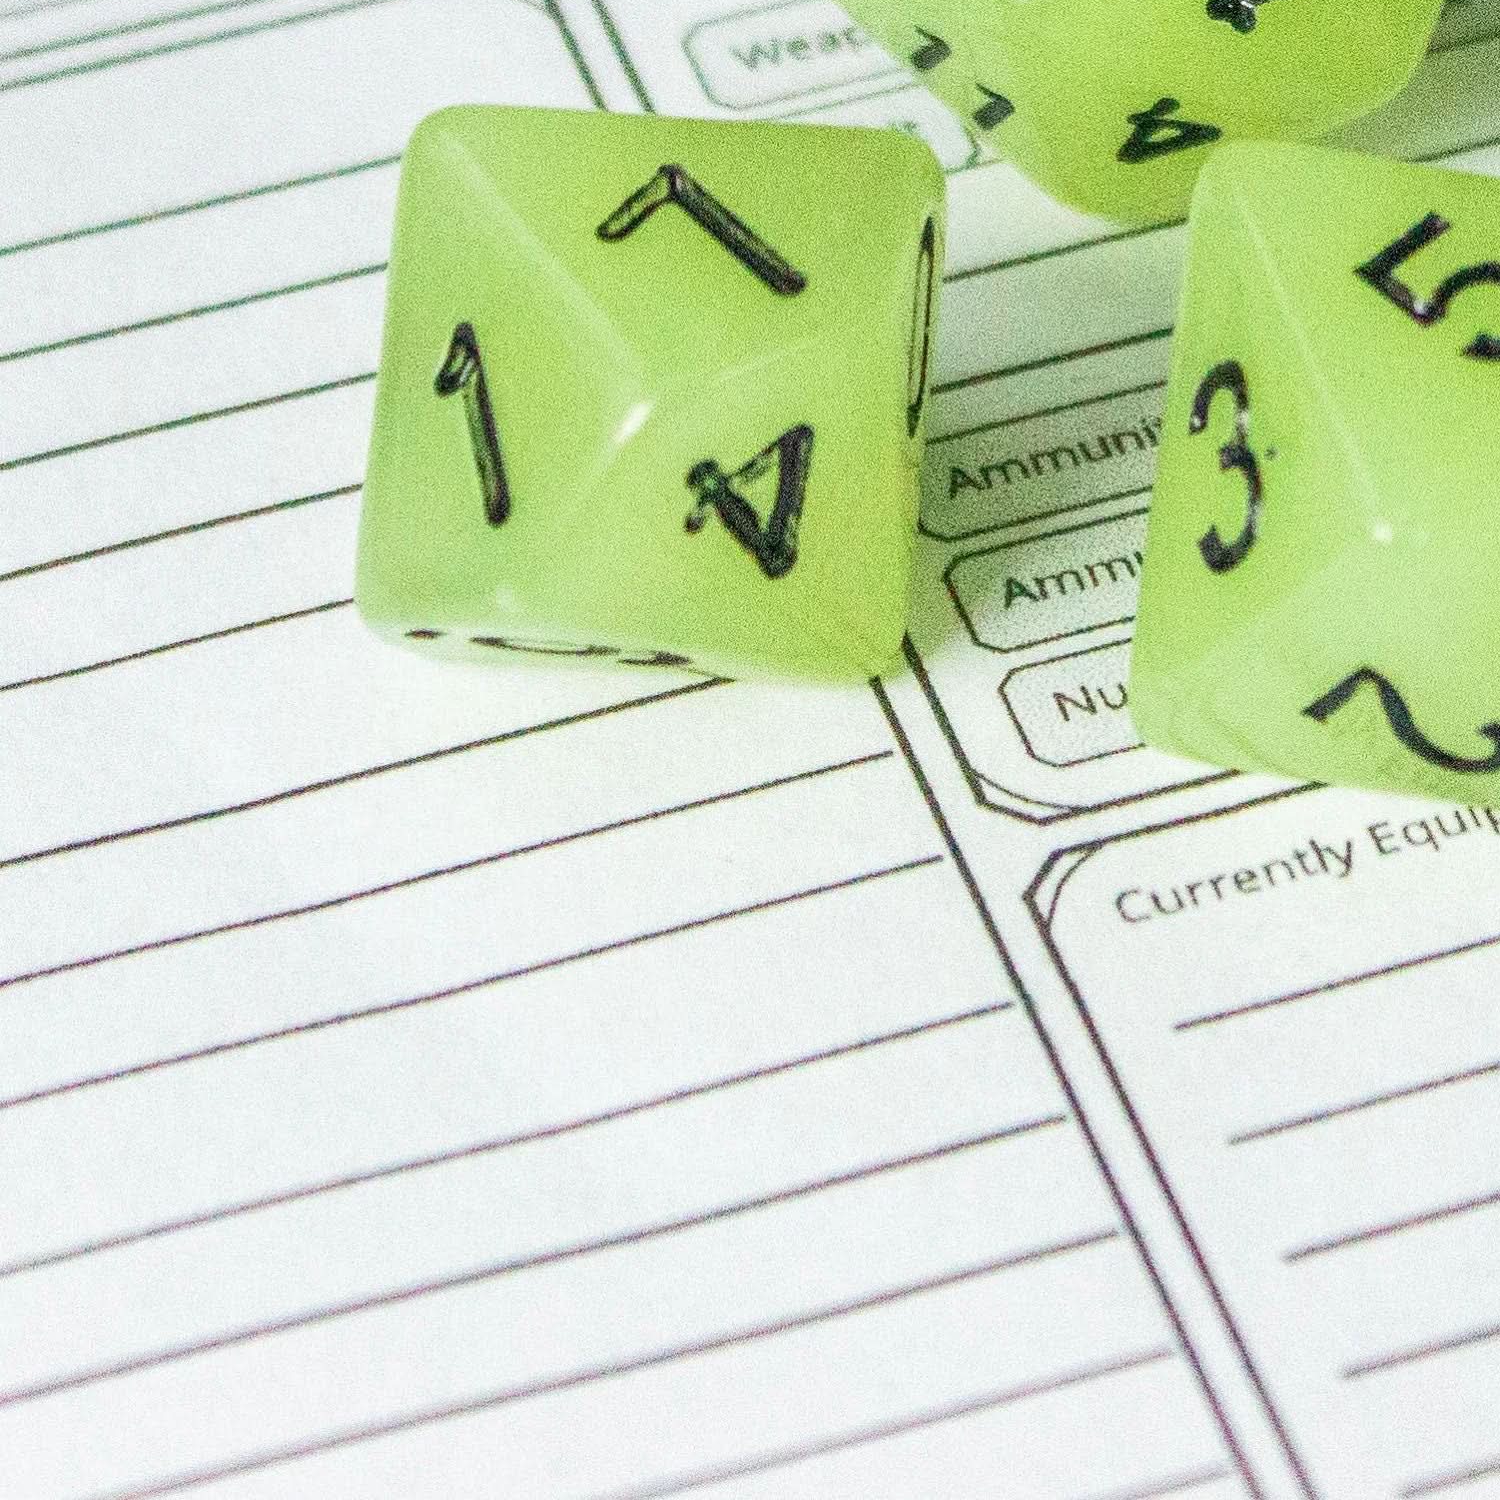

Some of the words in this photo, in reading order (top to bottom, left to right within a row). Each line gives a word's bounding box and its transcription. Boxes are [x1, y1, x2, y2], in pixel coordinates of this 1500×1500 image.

[1115, 95, 1223, 166] 4
[949, 417, 1160, 499] Ammuni
[1187, 358, 1264, 575] 3
[683, 421, 816, 582] 4
[1052, 682, 1129, 721] Nu
[1113, 837, 1355, 925] Currently
